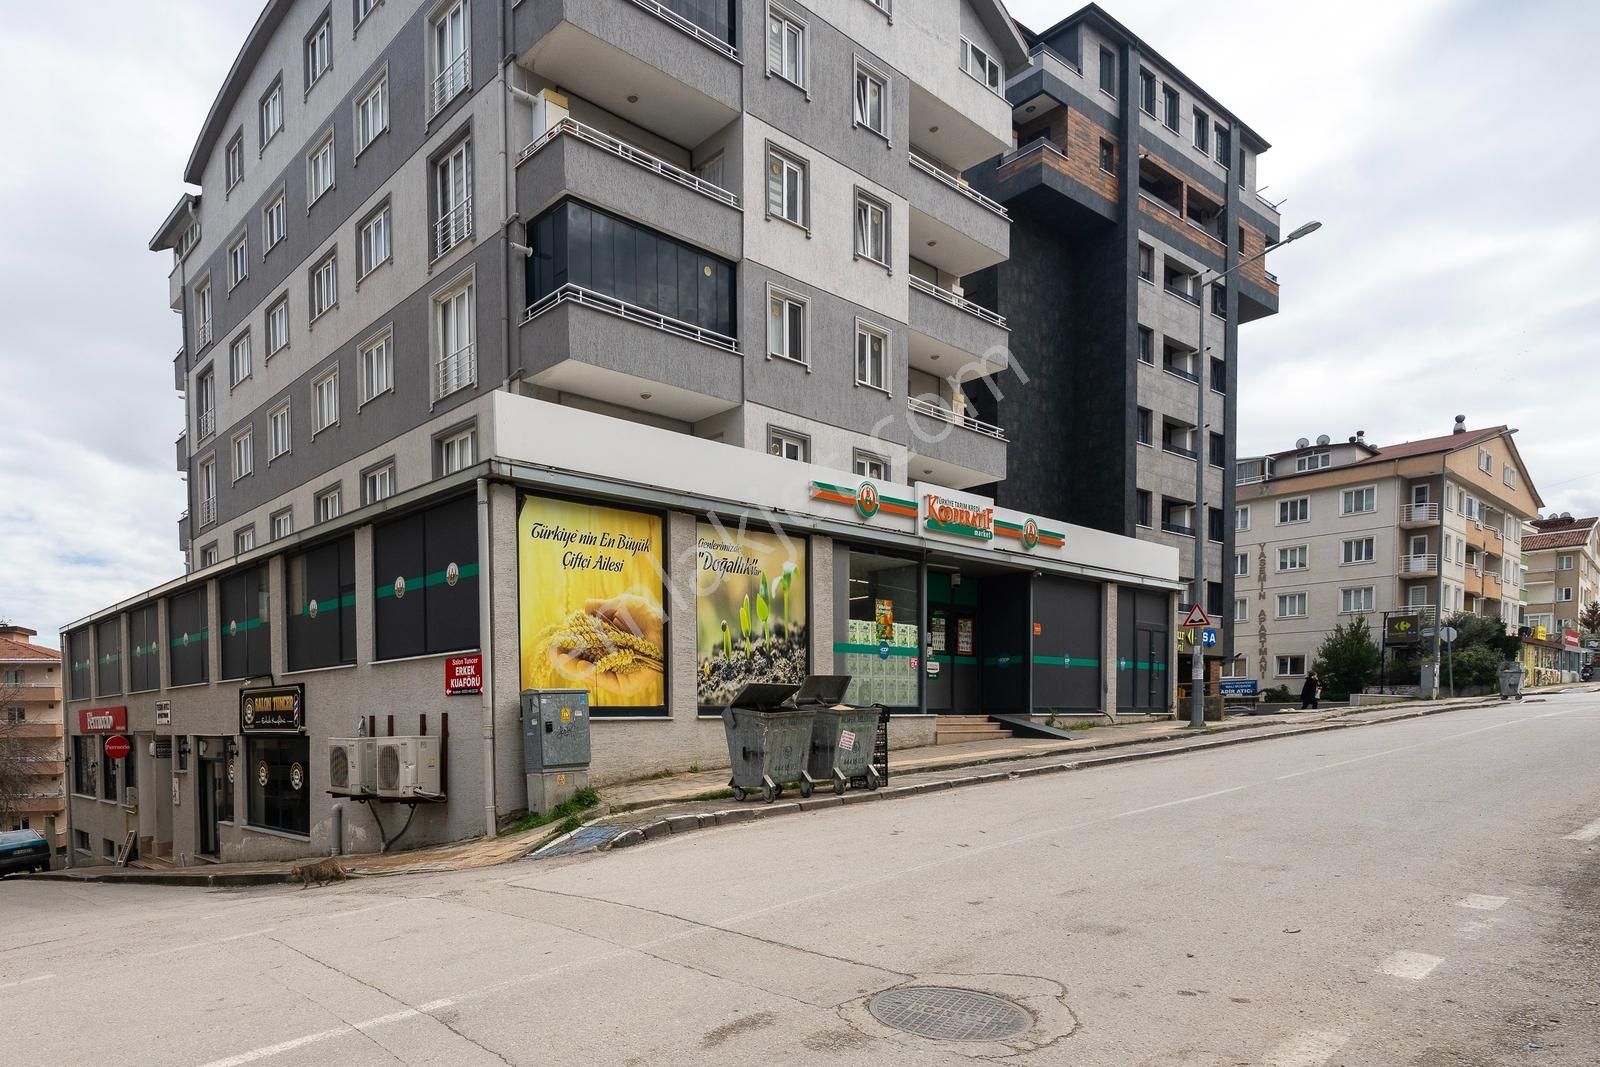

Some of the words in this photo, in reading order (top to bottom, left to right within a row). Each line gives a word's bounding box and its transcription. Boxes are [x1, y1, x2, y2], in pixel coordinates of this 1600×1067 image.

[974, 530, 991, 538] market
[600, 532, 615, 548] En
[617, 533, 650, 557] Büyük
[562, 551, 592, 571] Çiftçi
[1258, 609, 1267, 680] APARTMANI
[456, 665, 475, 676] ERKEK
[450, 674, 481, 688] KUAFÖRÜ
[255, 697, 271, 712] SALON
[272, 695, 293, 711] TUNCER
